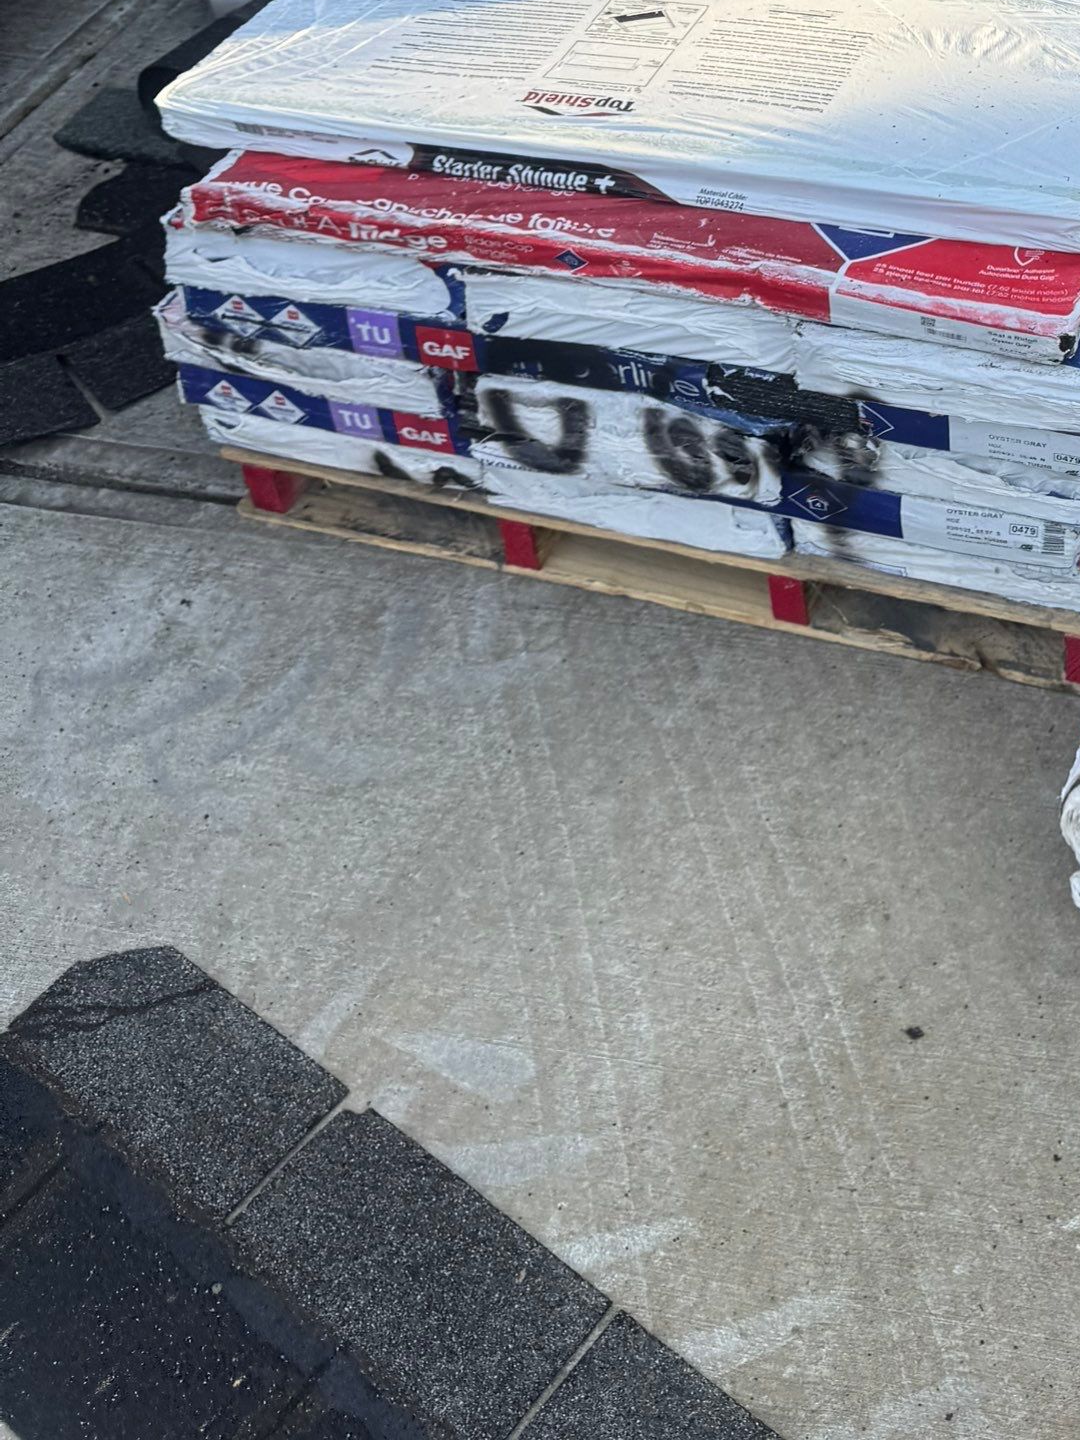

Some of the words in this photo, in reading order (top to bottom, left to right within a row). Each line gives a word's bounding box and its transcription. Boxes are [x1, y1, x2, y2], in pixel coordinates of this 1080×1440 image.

[521, 90, 635, 113] TopShield
[432, 155, 503, 180] Starter
[505, 163, 588, 191] Shingle
[700, 187, 727, 198] Material
[953, 276, 986, 289] bundle
[356, 321, 391, 345] TU
[422, 341, 471, 361] GAF
[1015, 341, 1032, 350] Gray
[338, 410, 371, 430] TU
[401, 426, 448, 446] GAF
[988, 434, 1021, 445] OYSTER
[1022, 439, 1047, 449] GRAY
[946, 507, 979, 518] OYSTER
[980, 511, 1005, 520] GRAY
[1010, 524, 1036, 537] 0479
